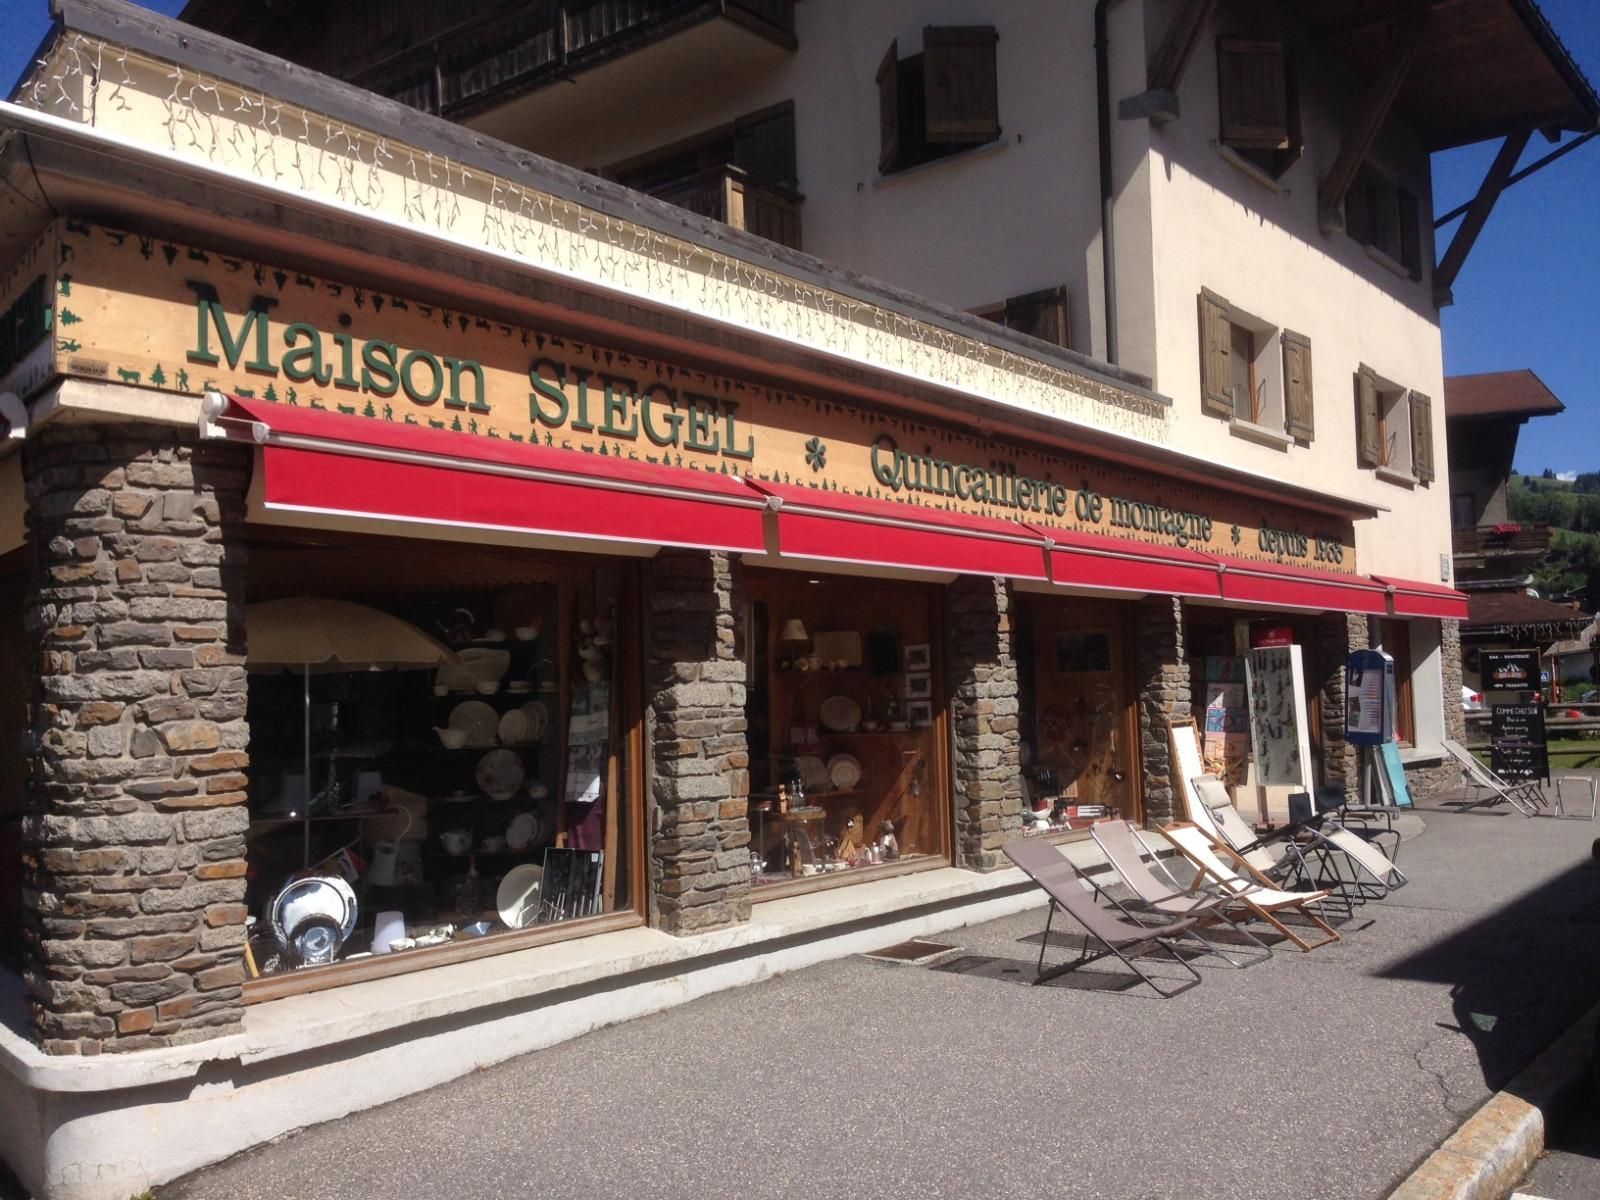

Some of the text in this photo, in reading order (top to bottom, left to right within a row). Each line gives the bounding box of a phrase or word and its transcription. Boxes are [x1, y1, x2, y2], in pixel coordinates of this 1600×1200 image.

[186, 279, 491, 414] Maison
[529, 357, 754, 462] SIEGEL
[871, 434, 1212, 547] Quincaillerie de montagne
[1258, 518, 1308, 560] depuis
